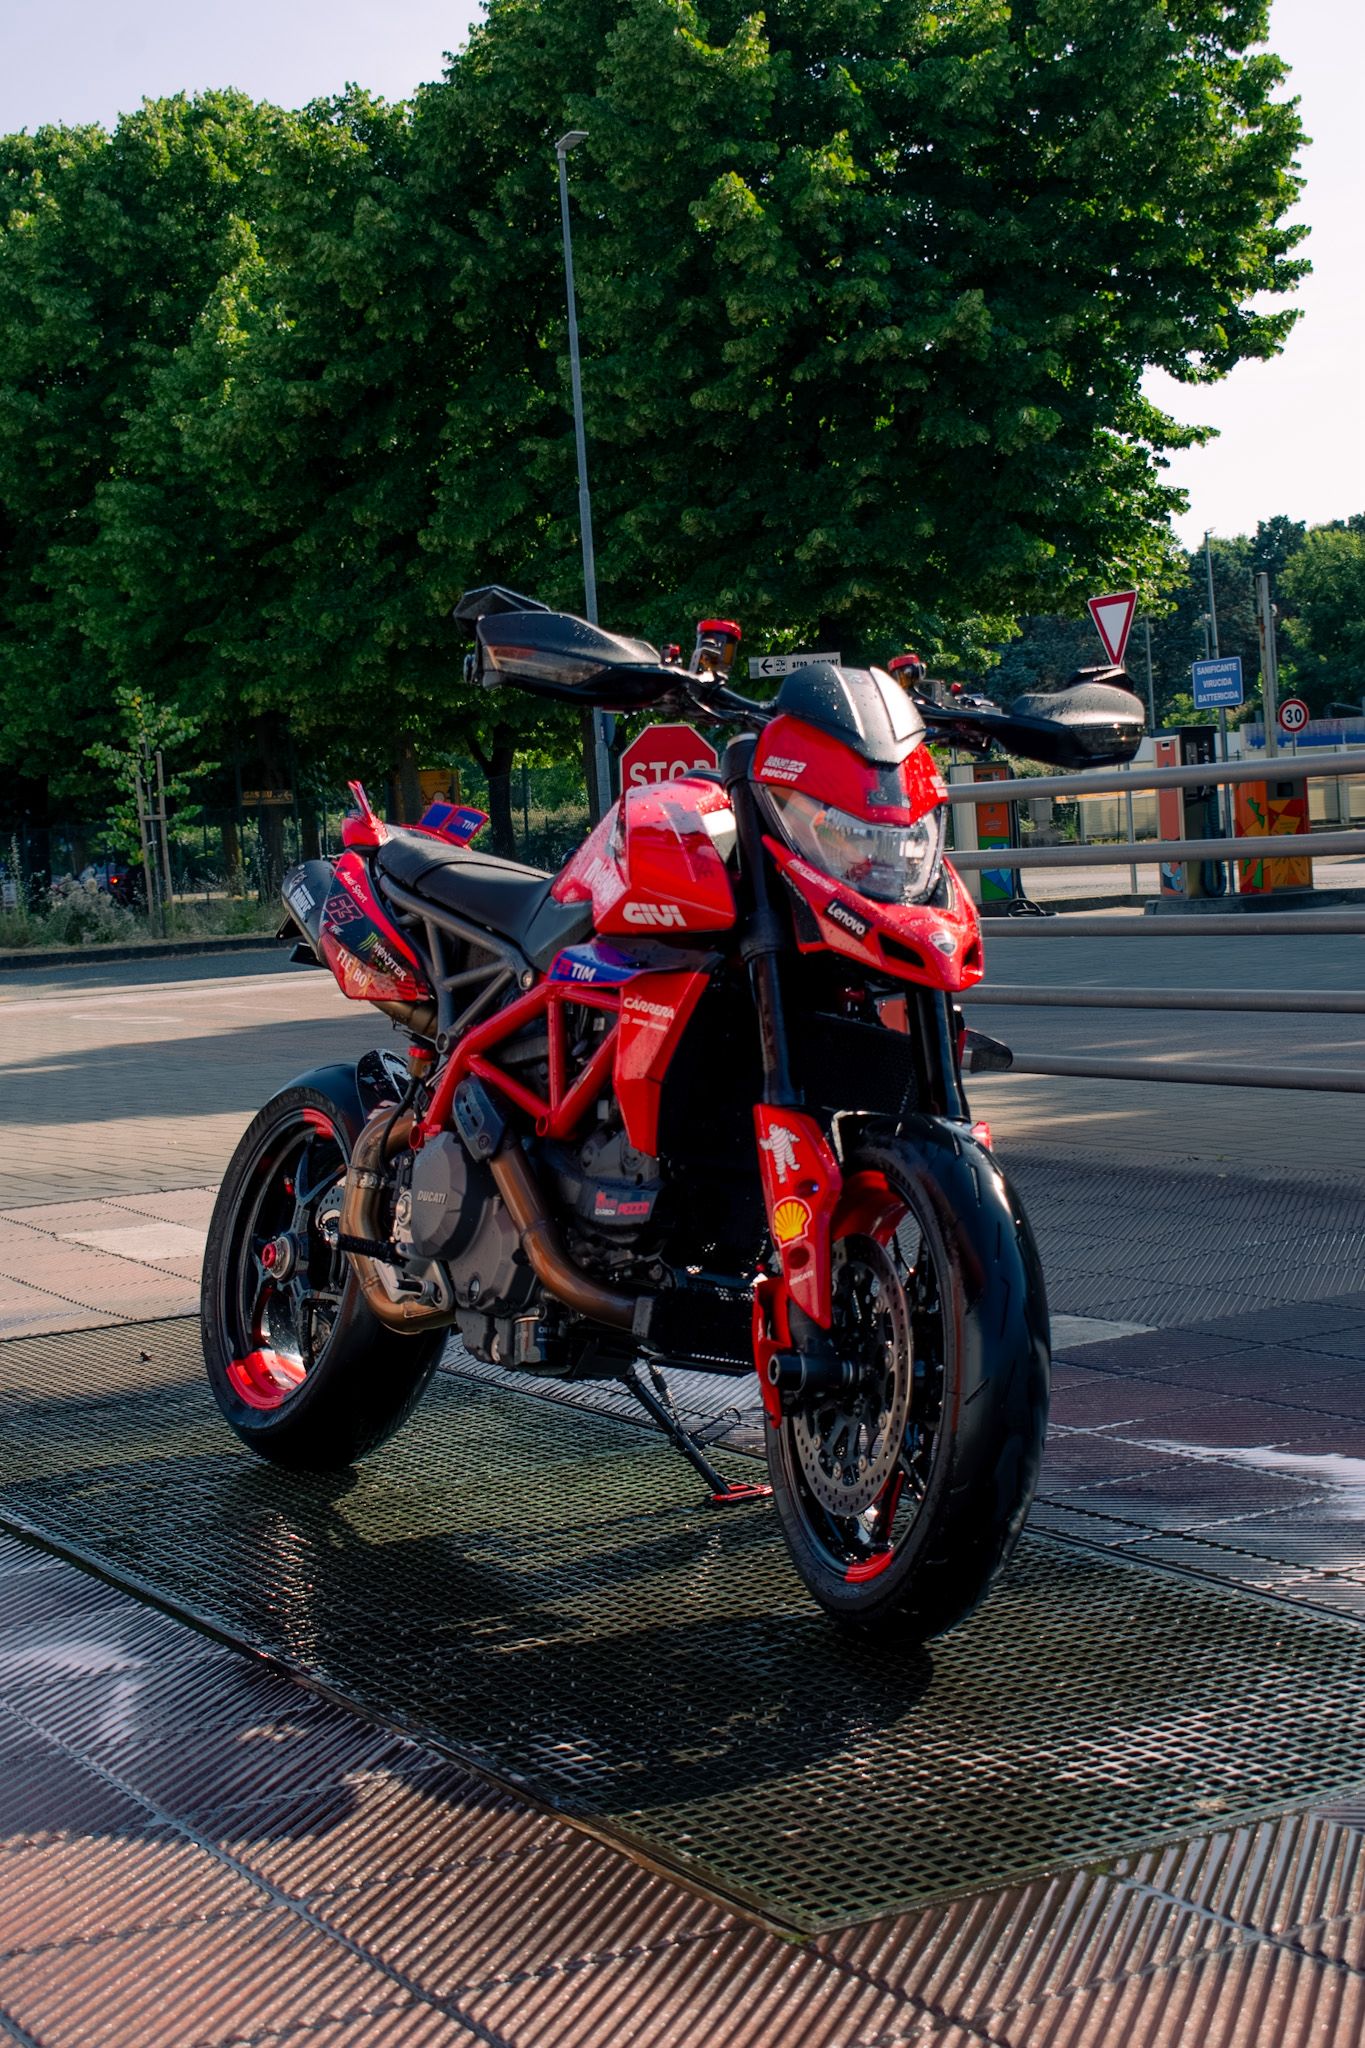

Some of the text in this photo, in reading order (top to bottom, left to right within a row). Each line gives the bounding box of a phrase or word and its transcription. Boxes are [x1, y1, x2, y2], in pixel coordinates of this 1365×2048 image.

[792, 660, 808, 669] area
[1196, 662, 1238, 676] SANIFICANTE
[1203, 677, 1233, 689] VIRUCIDA
[1197, 690, 1240, 703] BATTERICIDA
[1285, 708, 1302, 724] 30
[760, 767, 799, 782] DUCATI
[462, 819, 479, 832] TIM
[341, 871, 369, 904] Audi Sport
[622, 902, 688, 927] GIVI
[827, 901, 867, 936] Lenovo
[571, 961, 597, 983] TIM
[623, 997, 676, 1020] CARRERA
[416, 1190, 448, 1205] DUCATI
